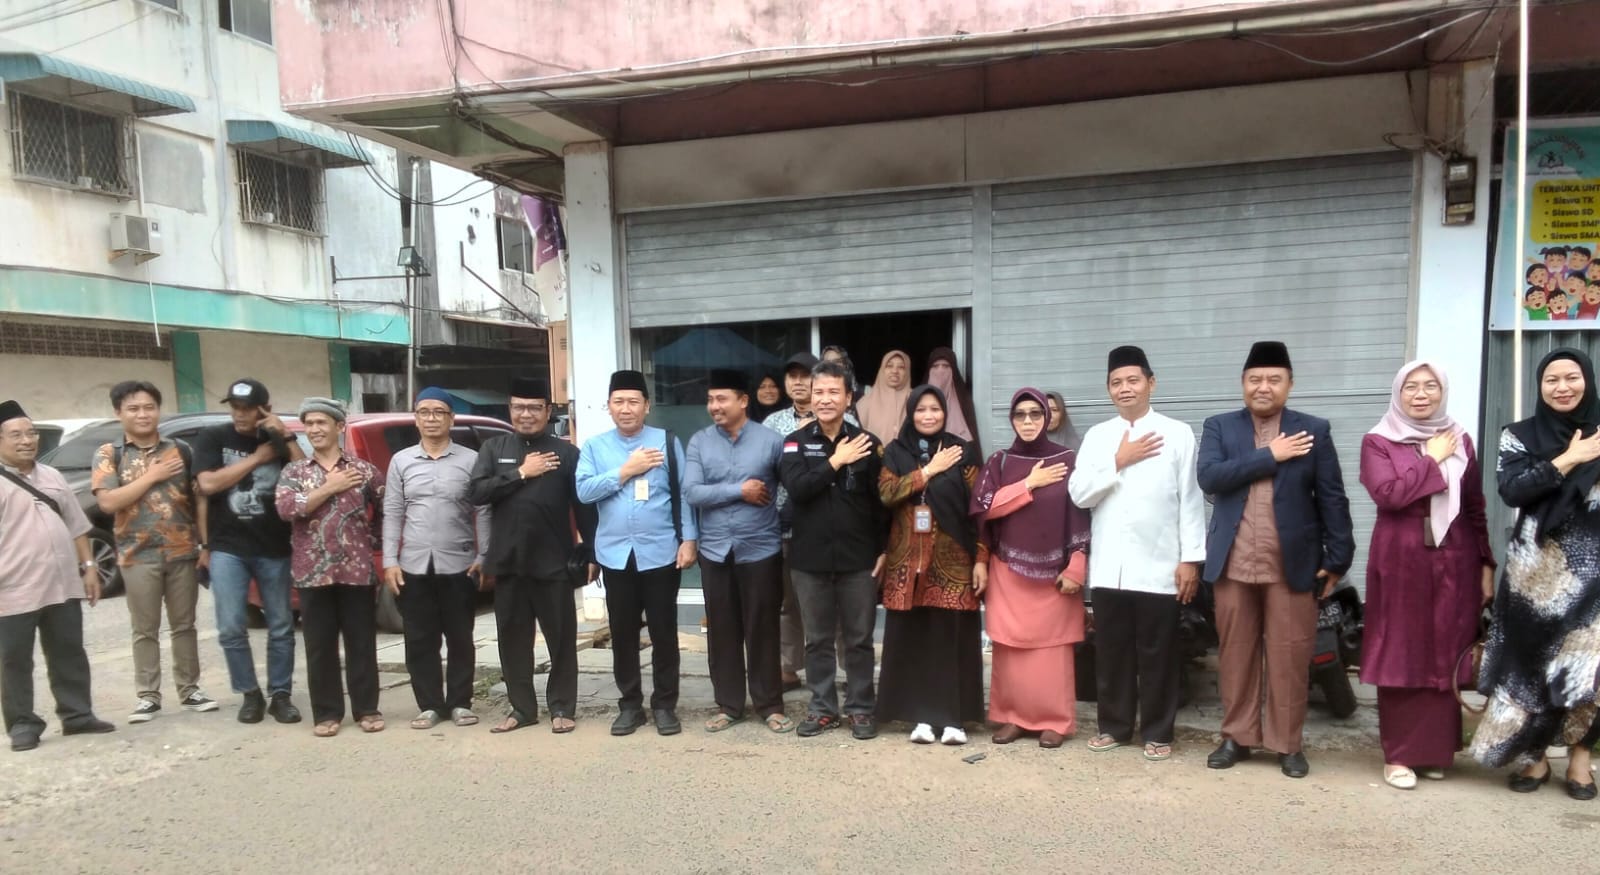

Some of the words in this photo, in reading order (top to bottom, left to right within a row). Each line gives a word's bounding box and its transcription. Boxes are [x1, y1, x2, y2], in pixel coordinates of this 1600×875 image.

[1539, 185, 1580, 193] TERBUKA
[1551, 220, 1579, 228] Siswa
[1580, 231, 1600, 239] SMA
